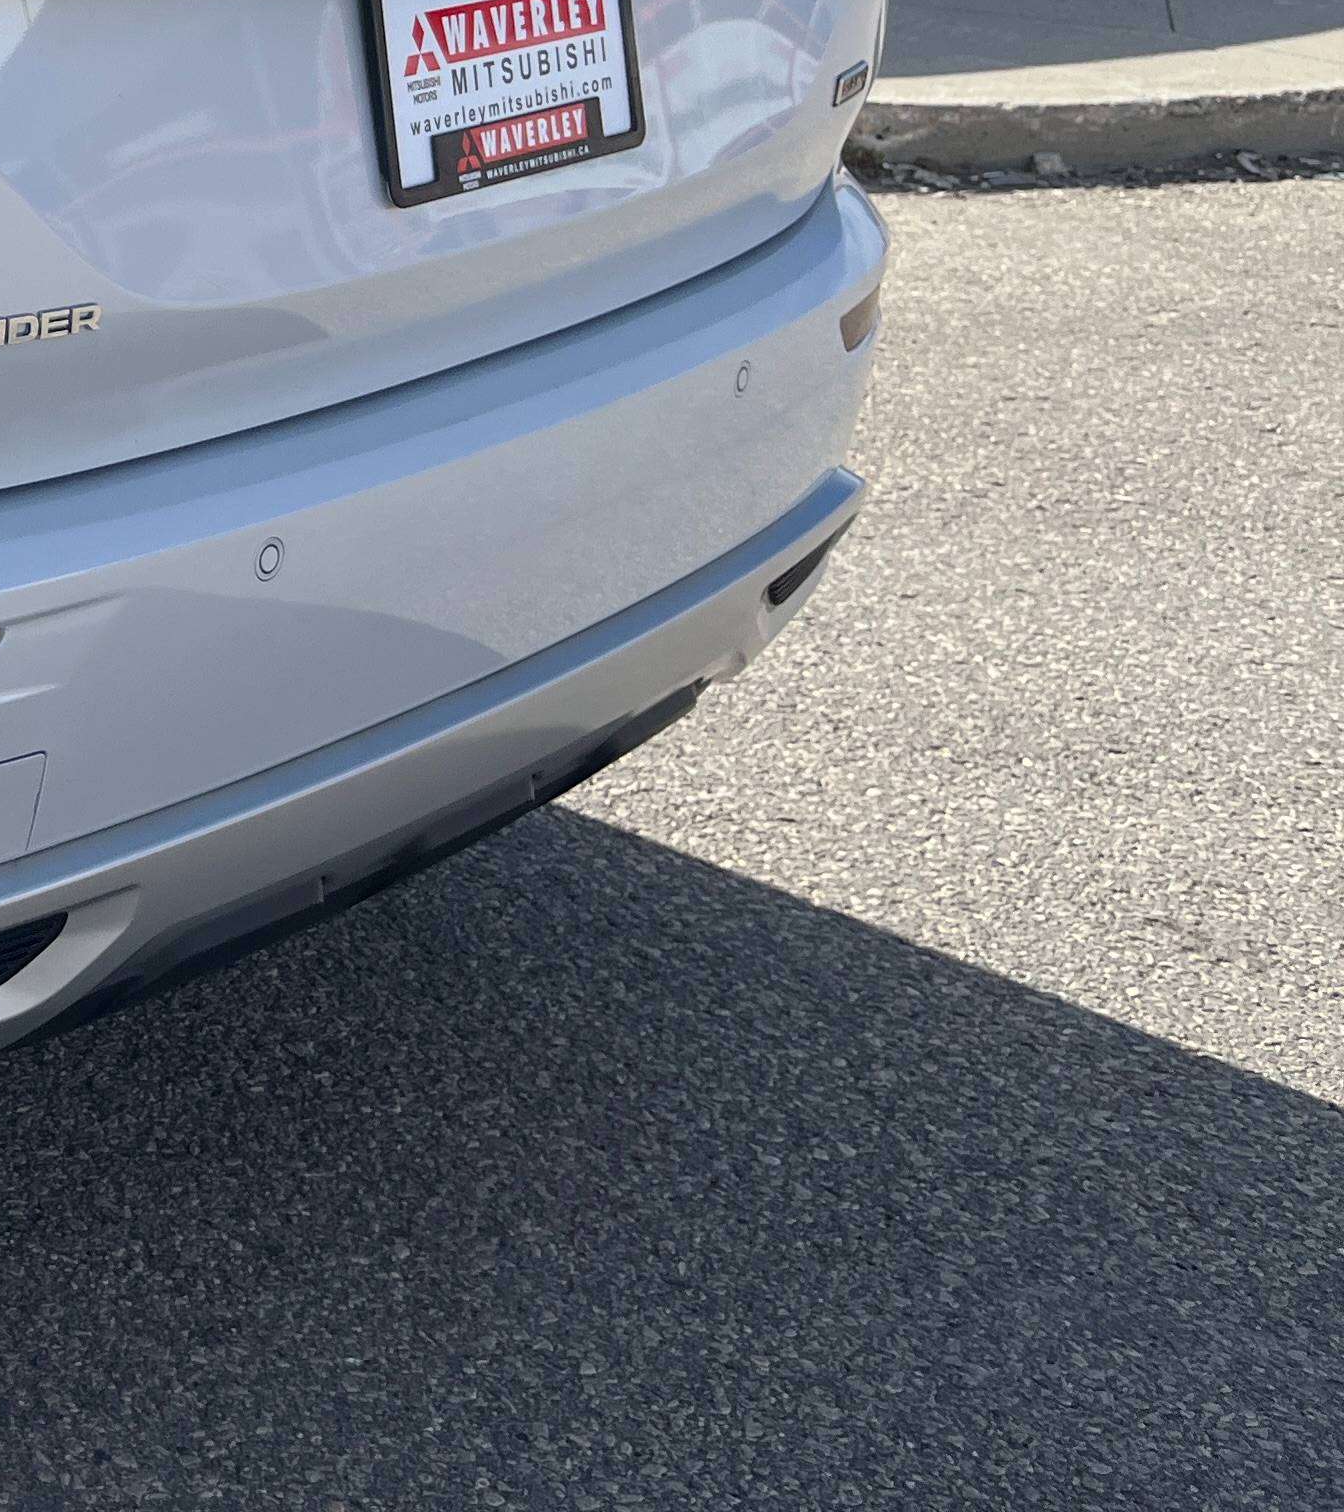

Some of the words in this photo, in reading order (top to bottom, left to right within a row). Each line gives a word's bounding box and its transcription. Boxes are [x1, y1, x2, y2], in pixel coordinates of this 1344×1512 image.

[451, 36, 607, 96] MITSUBISHI
[410, 74, 613, 136] waverleymitsubishi.com
[480, 108, 584, 158] WAVERLEY
[486, 144, 591, 179] WAVERLEYMITSUBISHI.CA
